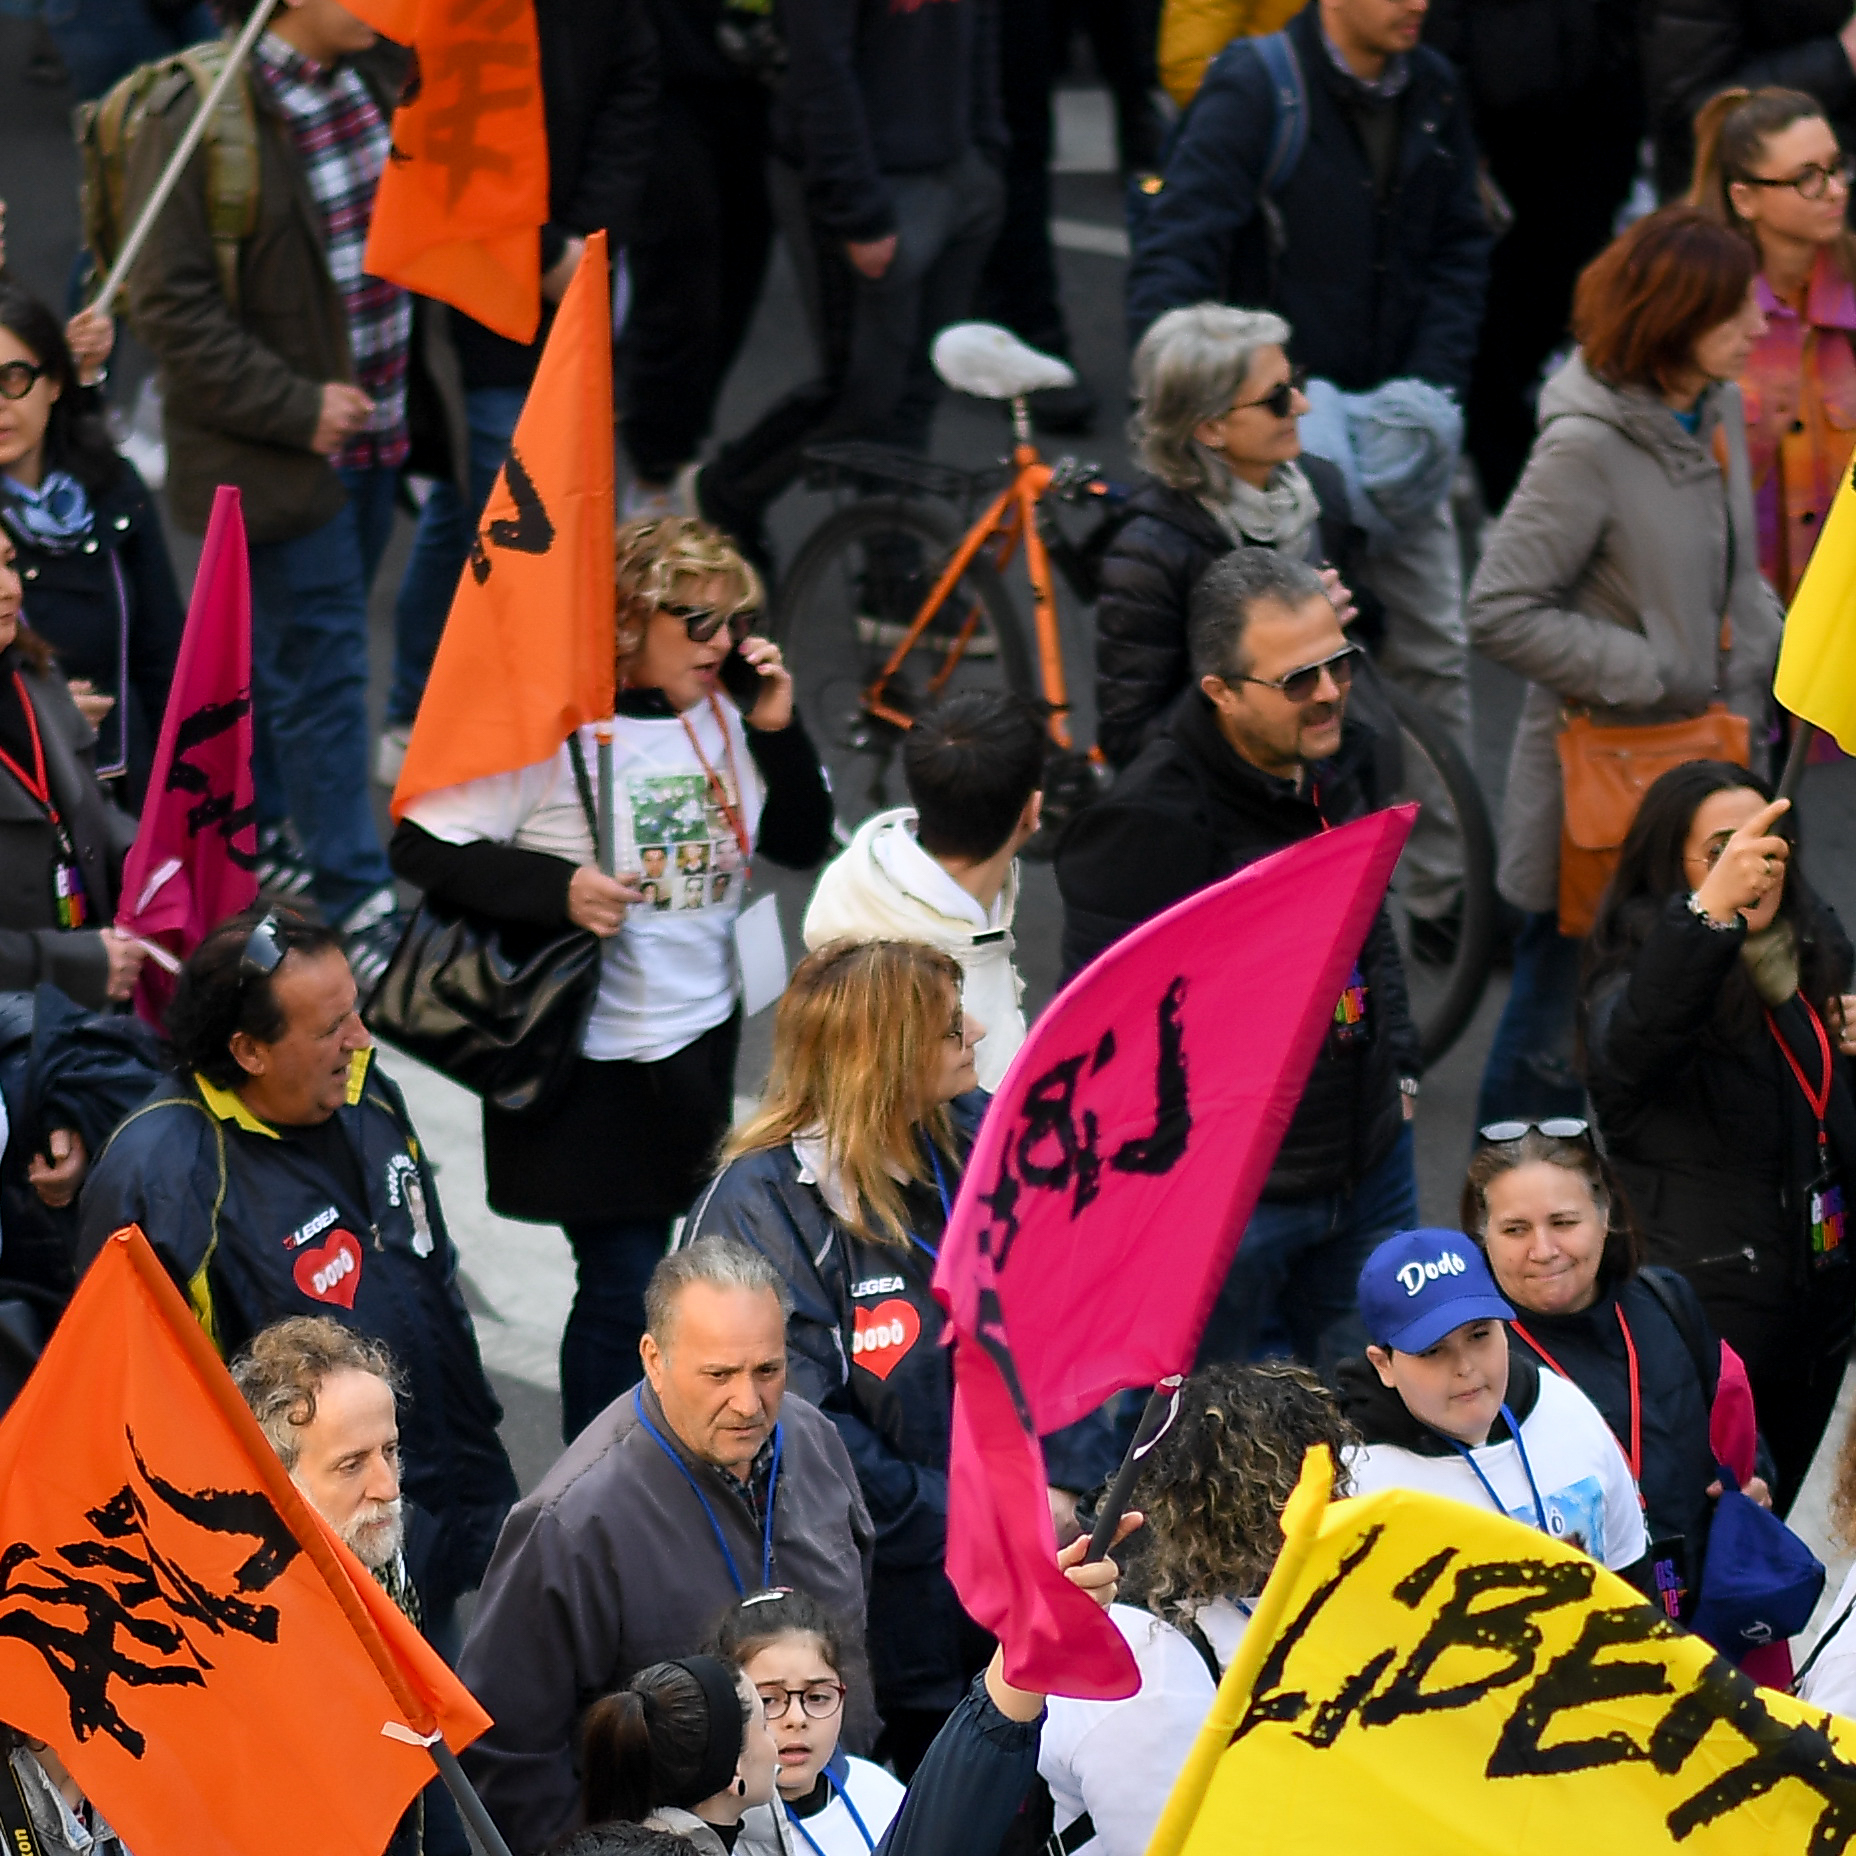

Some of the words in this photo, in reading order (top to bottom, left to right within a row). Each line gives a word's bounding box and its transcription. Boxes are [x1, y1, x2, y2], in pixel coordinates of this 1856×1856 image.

[294, 1206, 341, 1246] LEGEA
[850, 1276, 905, 1297] LEGEA
[1396, 1251, 1466, 1297] Dodò
